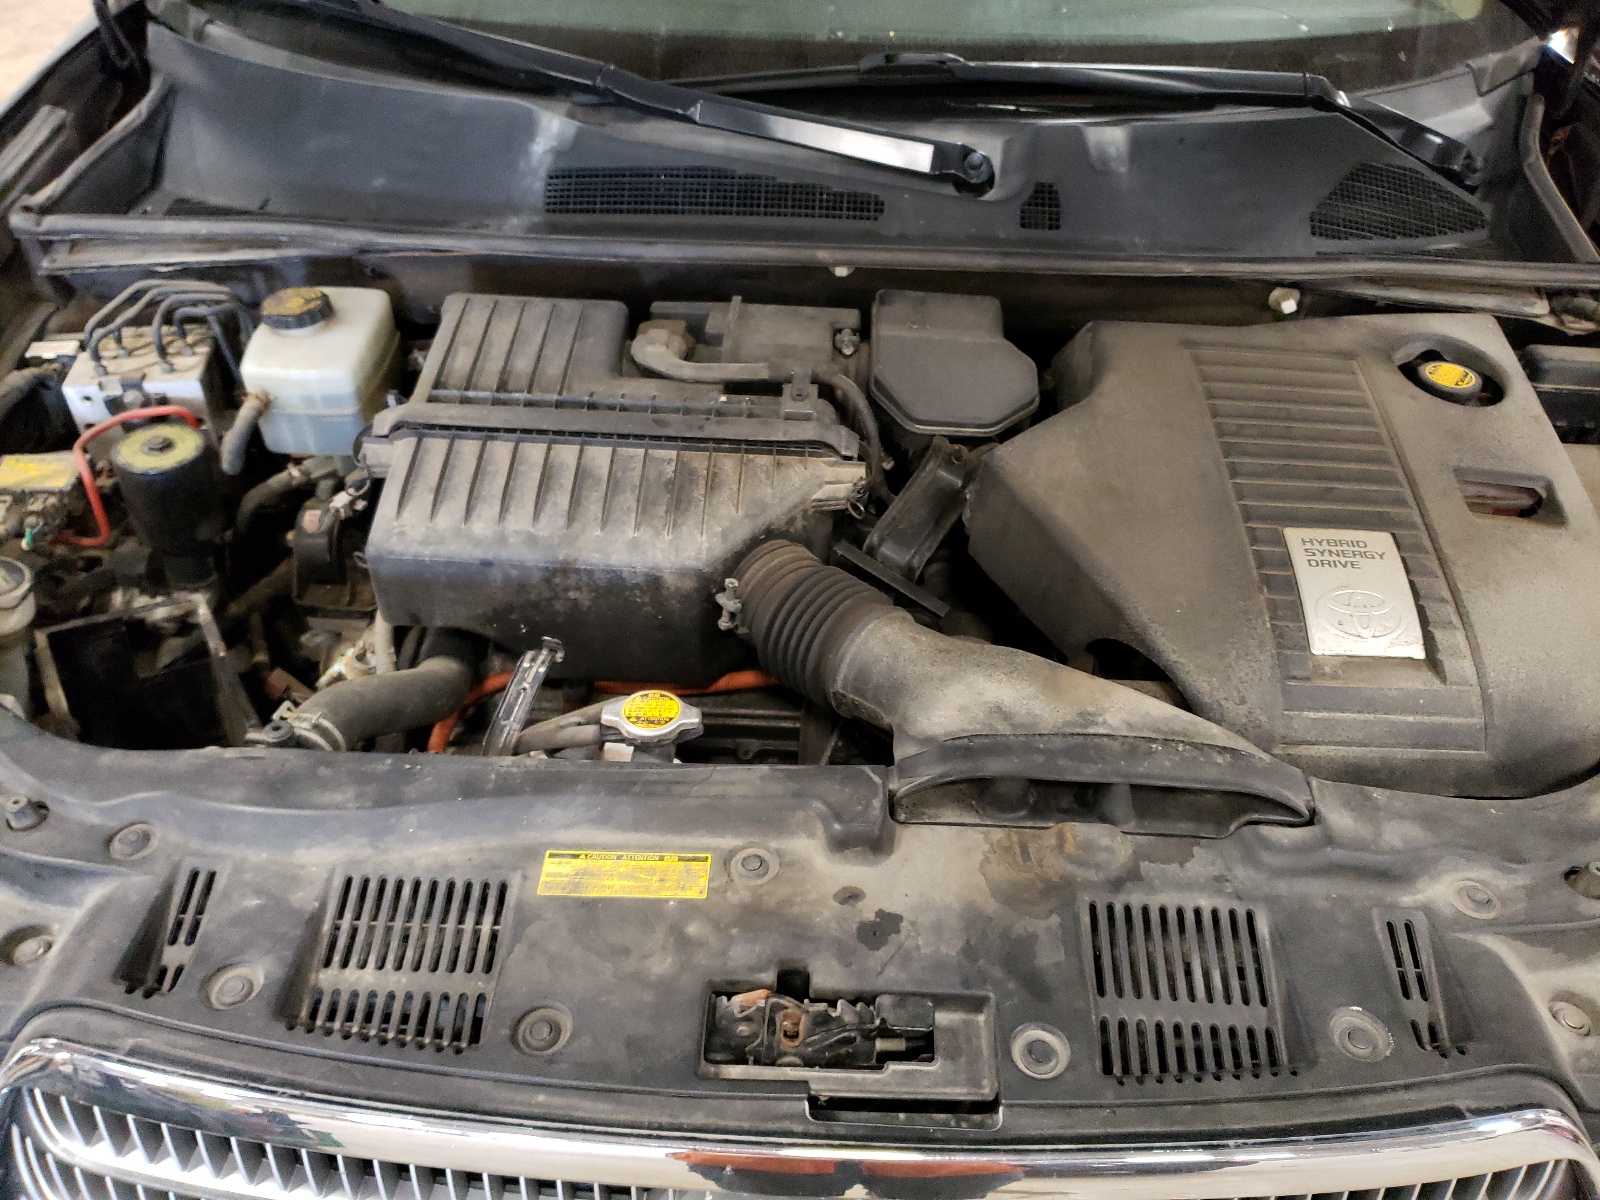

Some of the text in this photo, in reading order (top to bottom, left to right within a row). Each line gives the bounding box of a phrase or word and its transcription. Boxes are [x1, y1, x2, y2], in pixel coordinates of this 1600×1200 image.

[1301, 537, 1368, 548] HYBRID
[1304, 548, 1386, 559] SYNERGY
[1307, 559, 1362, 569] DRIVE
